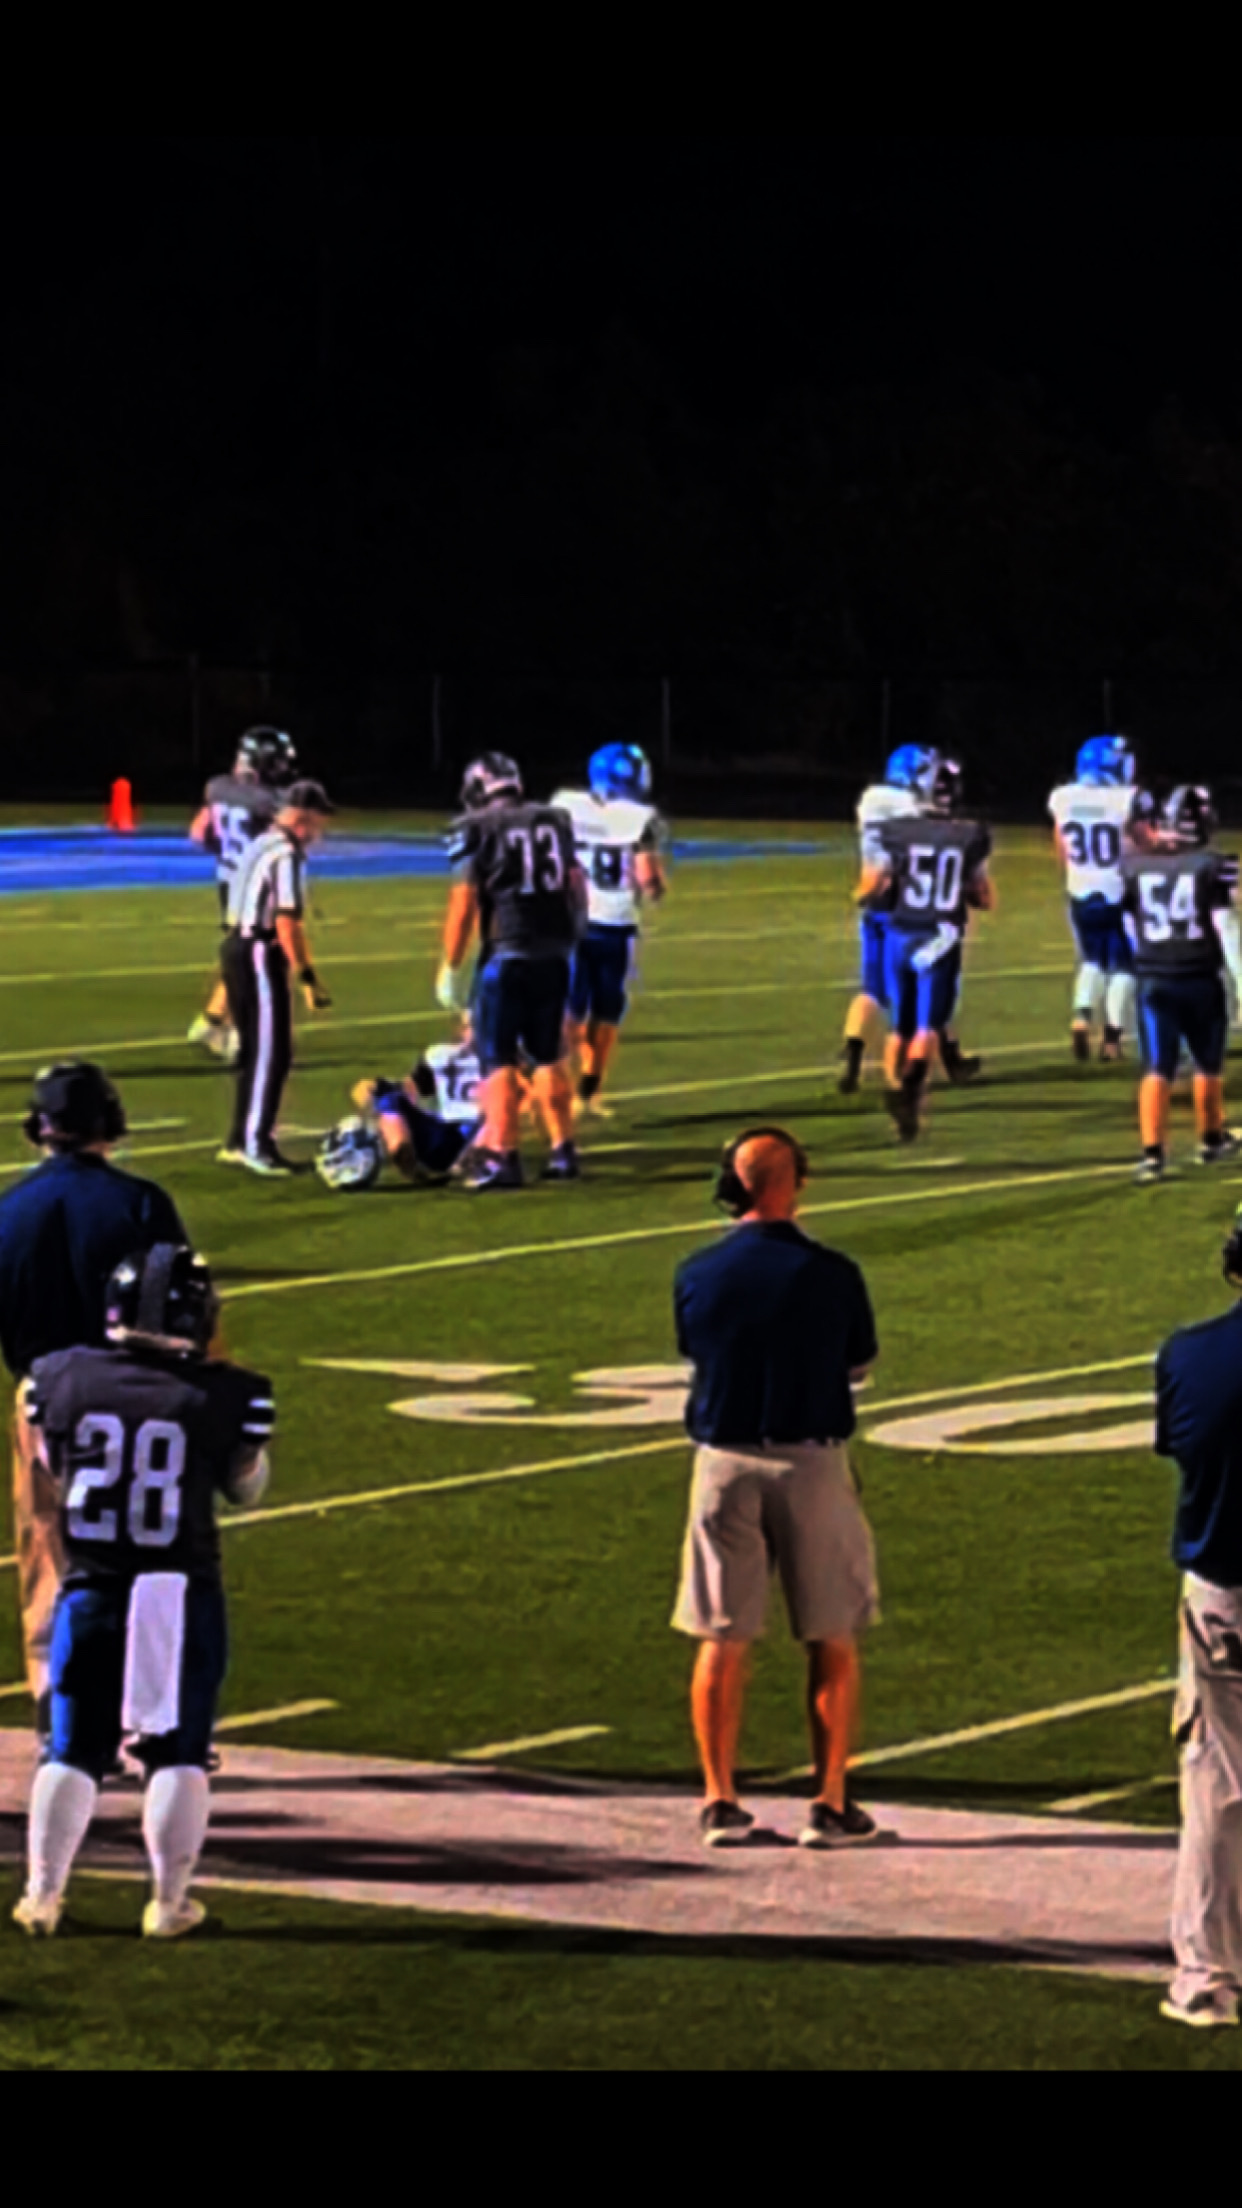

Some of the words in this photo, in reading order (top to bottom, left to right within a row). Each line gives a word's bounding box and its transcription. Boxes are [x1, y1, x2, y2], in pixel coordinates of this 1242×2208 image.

[506, 825, 565, 895] 73
[904, 844, 963, 910] 50
[1061, 820, 1121, 869] 30
[1138, 873, 1203, 942] 54
[66, 1412, 187, 1547] 28
